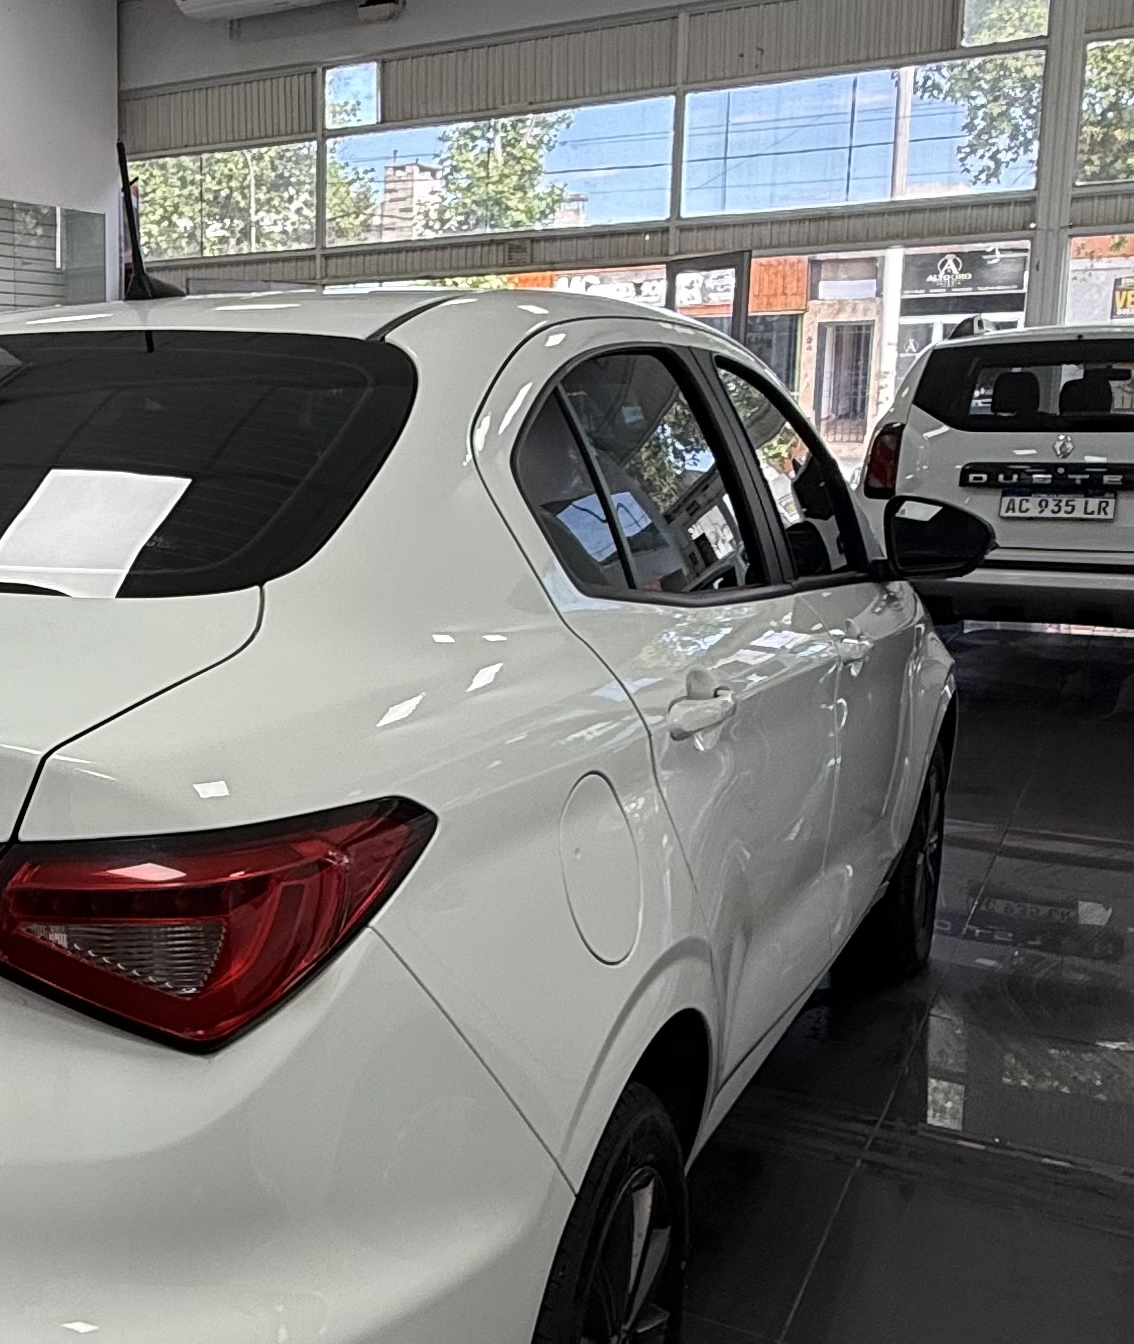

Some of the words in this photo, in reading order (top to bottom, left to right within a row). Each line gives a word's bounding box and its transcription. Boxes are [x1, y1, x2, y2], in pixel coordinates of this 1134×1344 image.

[1004, 498, 1030, 514] AC
[1038, 498, 1076, 515] 935
[1083, 499, 1110, 516] LR
